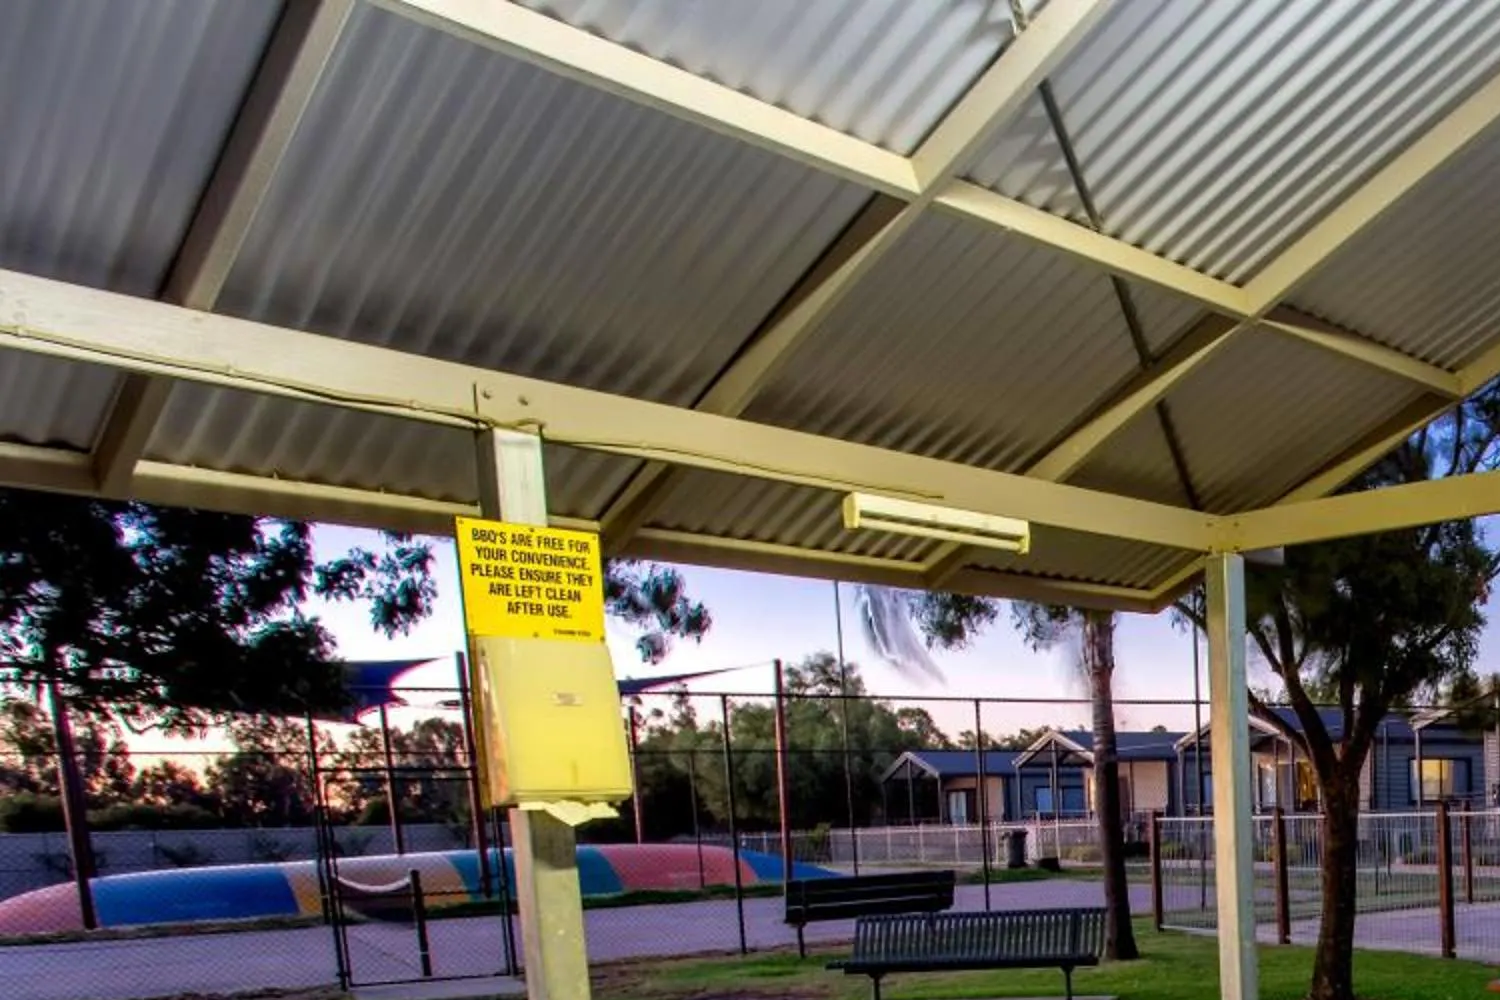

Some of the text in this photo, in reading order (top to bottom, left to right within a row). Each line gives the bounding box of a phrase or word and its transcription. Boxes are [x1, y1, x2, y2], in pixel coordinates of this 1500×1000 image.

[472, 528, 590, 553] BBQ'S ARE FREE FOR
[475, 546, 590, 570] YOUR CONVENIENCE.
[471, 563, 593, 586] PLEASE ENSURE THEY
[489, 583, 581, 602] ARE LEFT CLEAN
[508, 601, 572, 619] AFTER USE.
